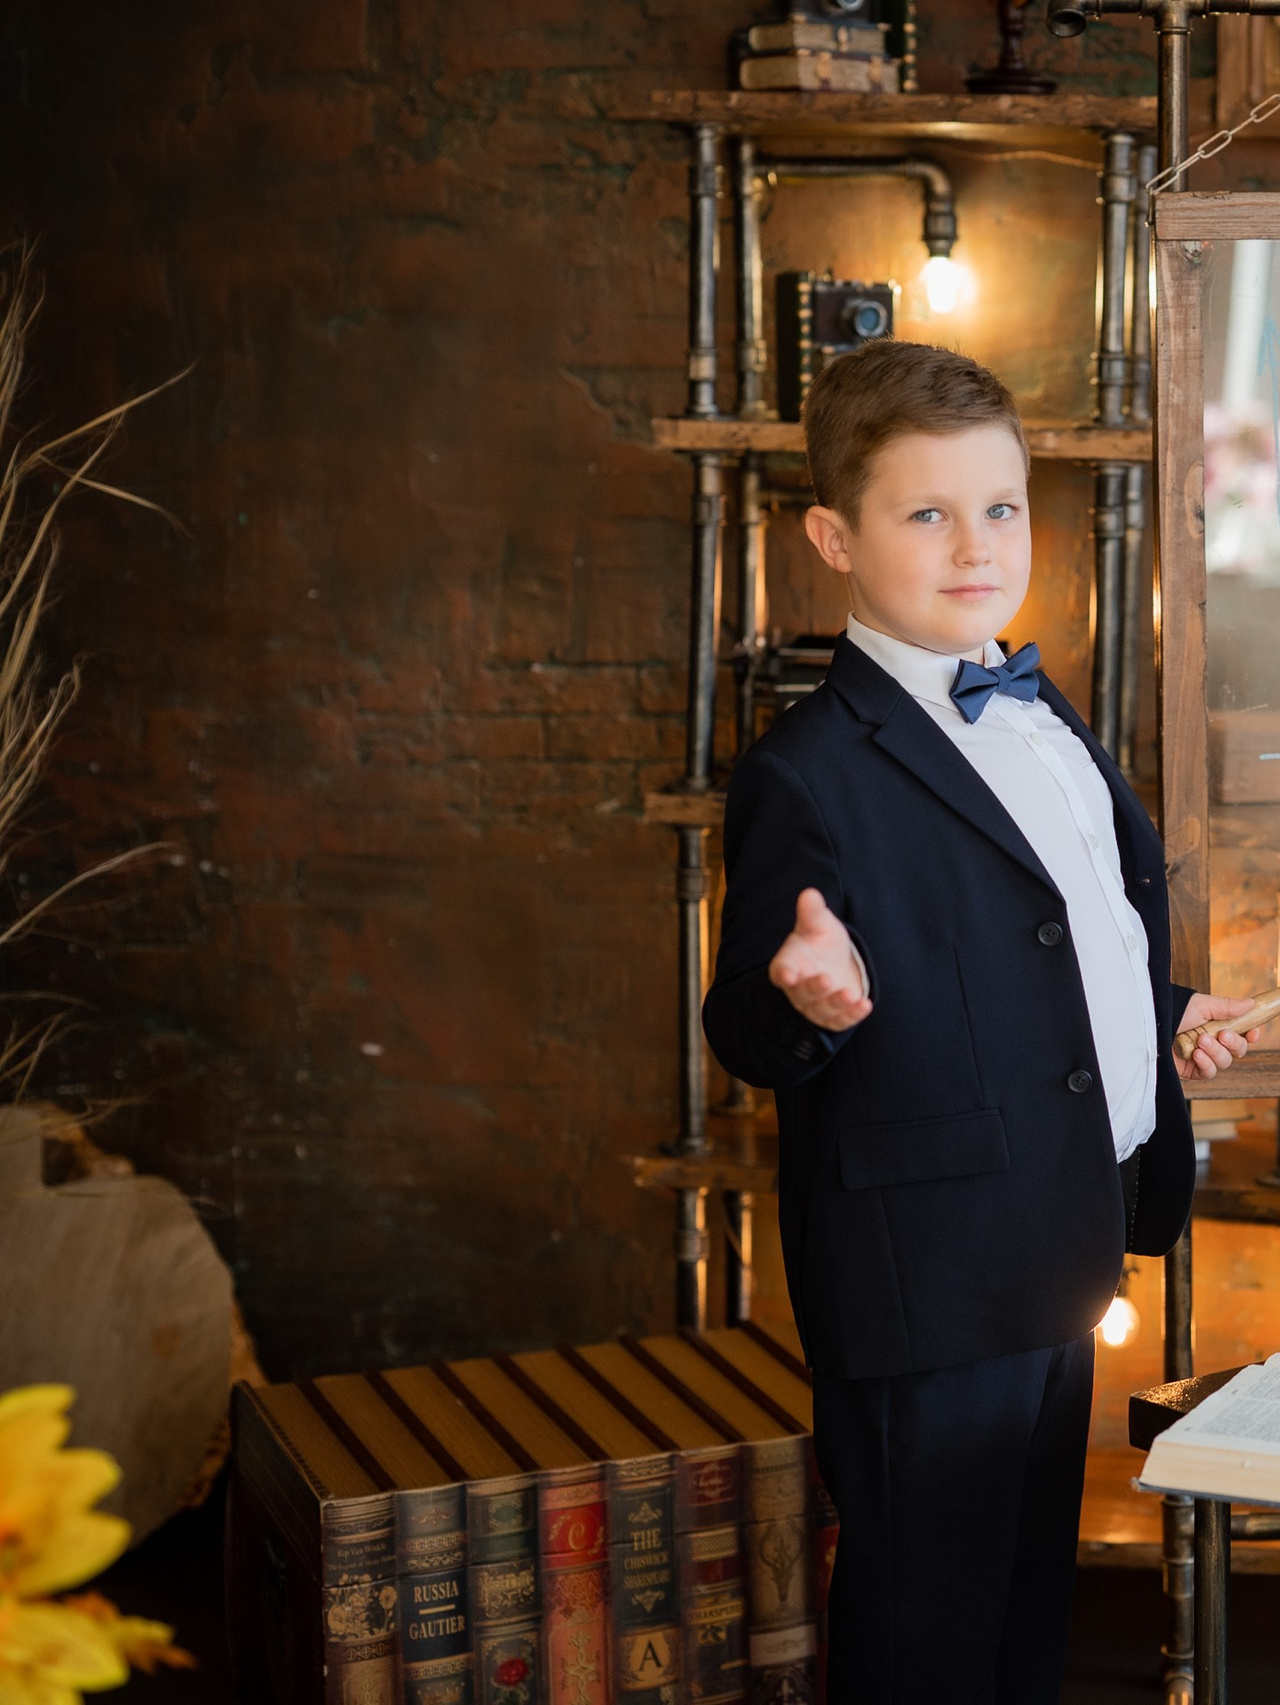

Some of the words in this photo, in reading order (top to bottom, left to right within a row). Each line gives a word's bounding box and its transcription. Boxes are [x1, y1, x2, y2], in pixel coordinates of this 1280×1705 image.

[631, 1527, 662, 1552] THE
[413, 1580, 459, 1603] RUSSIA
[409, 1614, 466, 1641] GAUTIER
[639, 1639, 663, 1672] A
